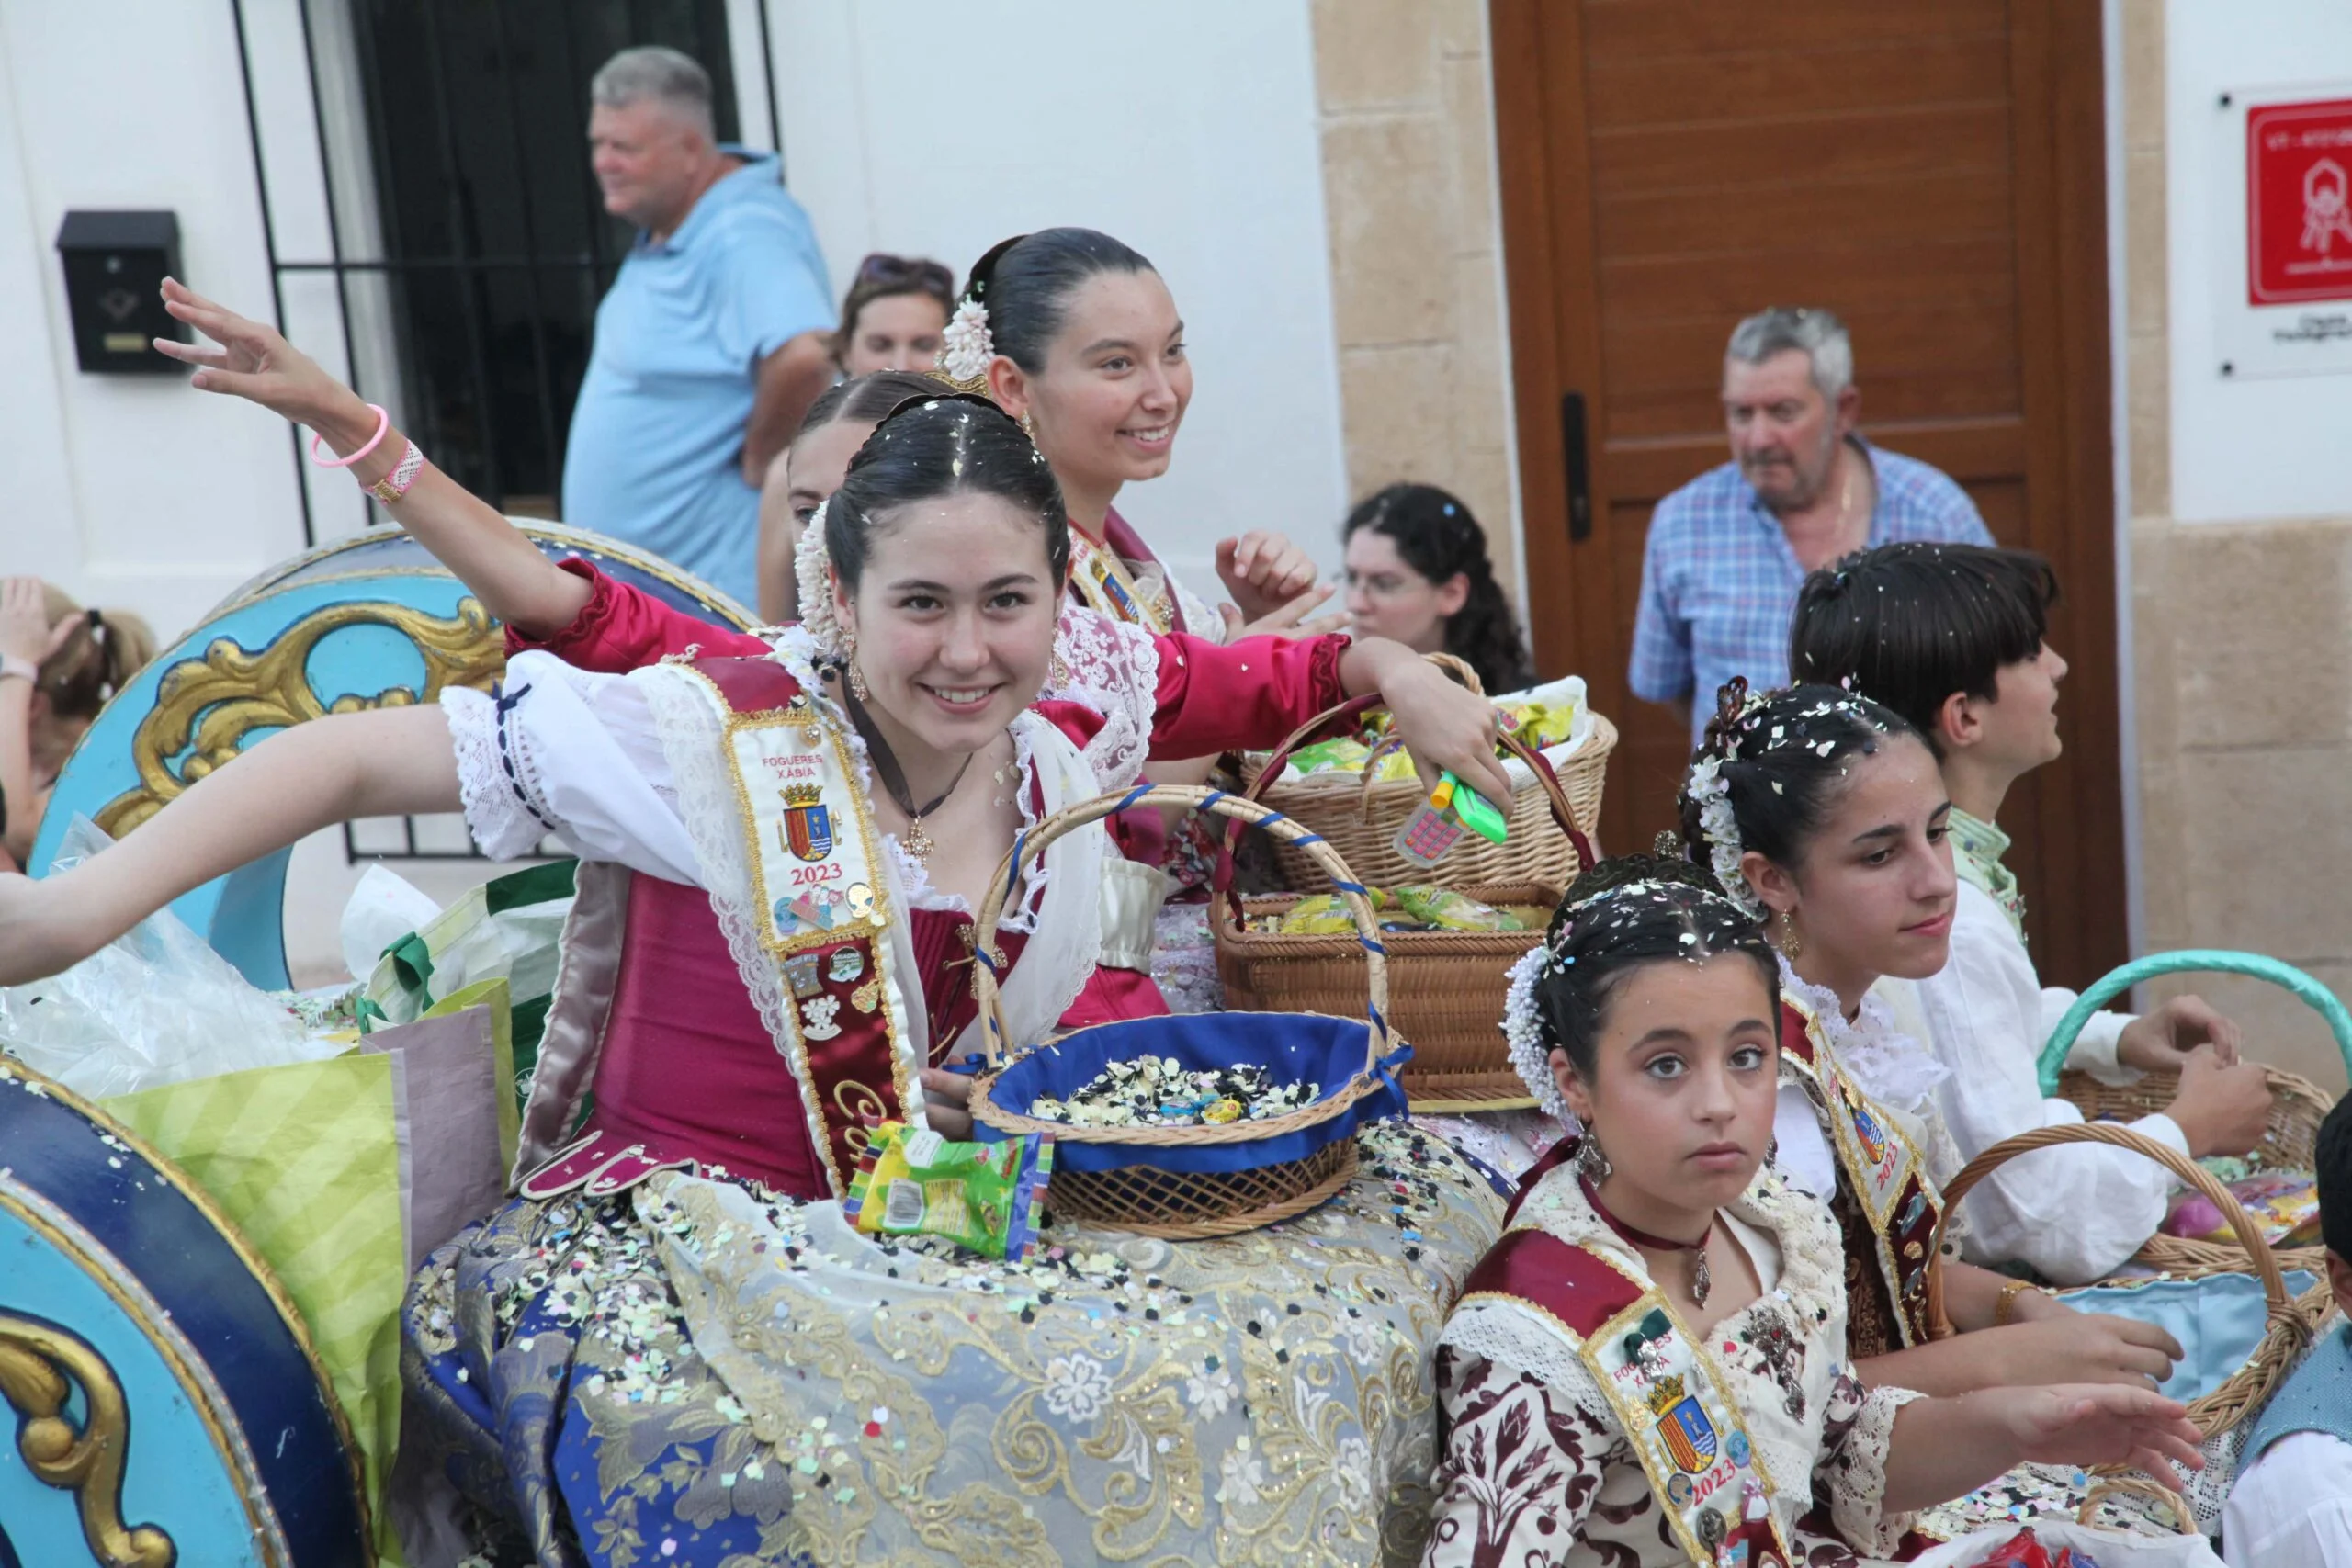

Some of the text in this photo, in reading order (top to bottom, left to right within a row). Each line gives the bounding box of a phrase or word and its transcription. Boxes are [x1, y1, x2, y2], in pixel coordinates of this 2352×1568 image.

[762, 754, 823, 767] FOGUERES
[790, 863, 843, 886] 2023
[1877, 1141, 1897, 1191] 2023
[1613, 1332, 1672, 1382] FOGES
[1692, 1458, 1736, 1507] 2023
